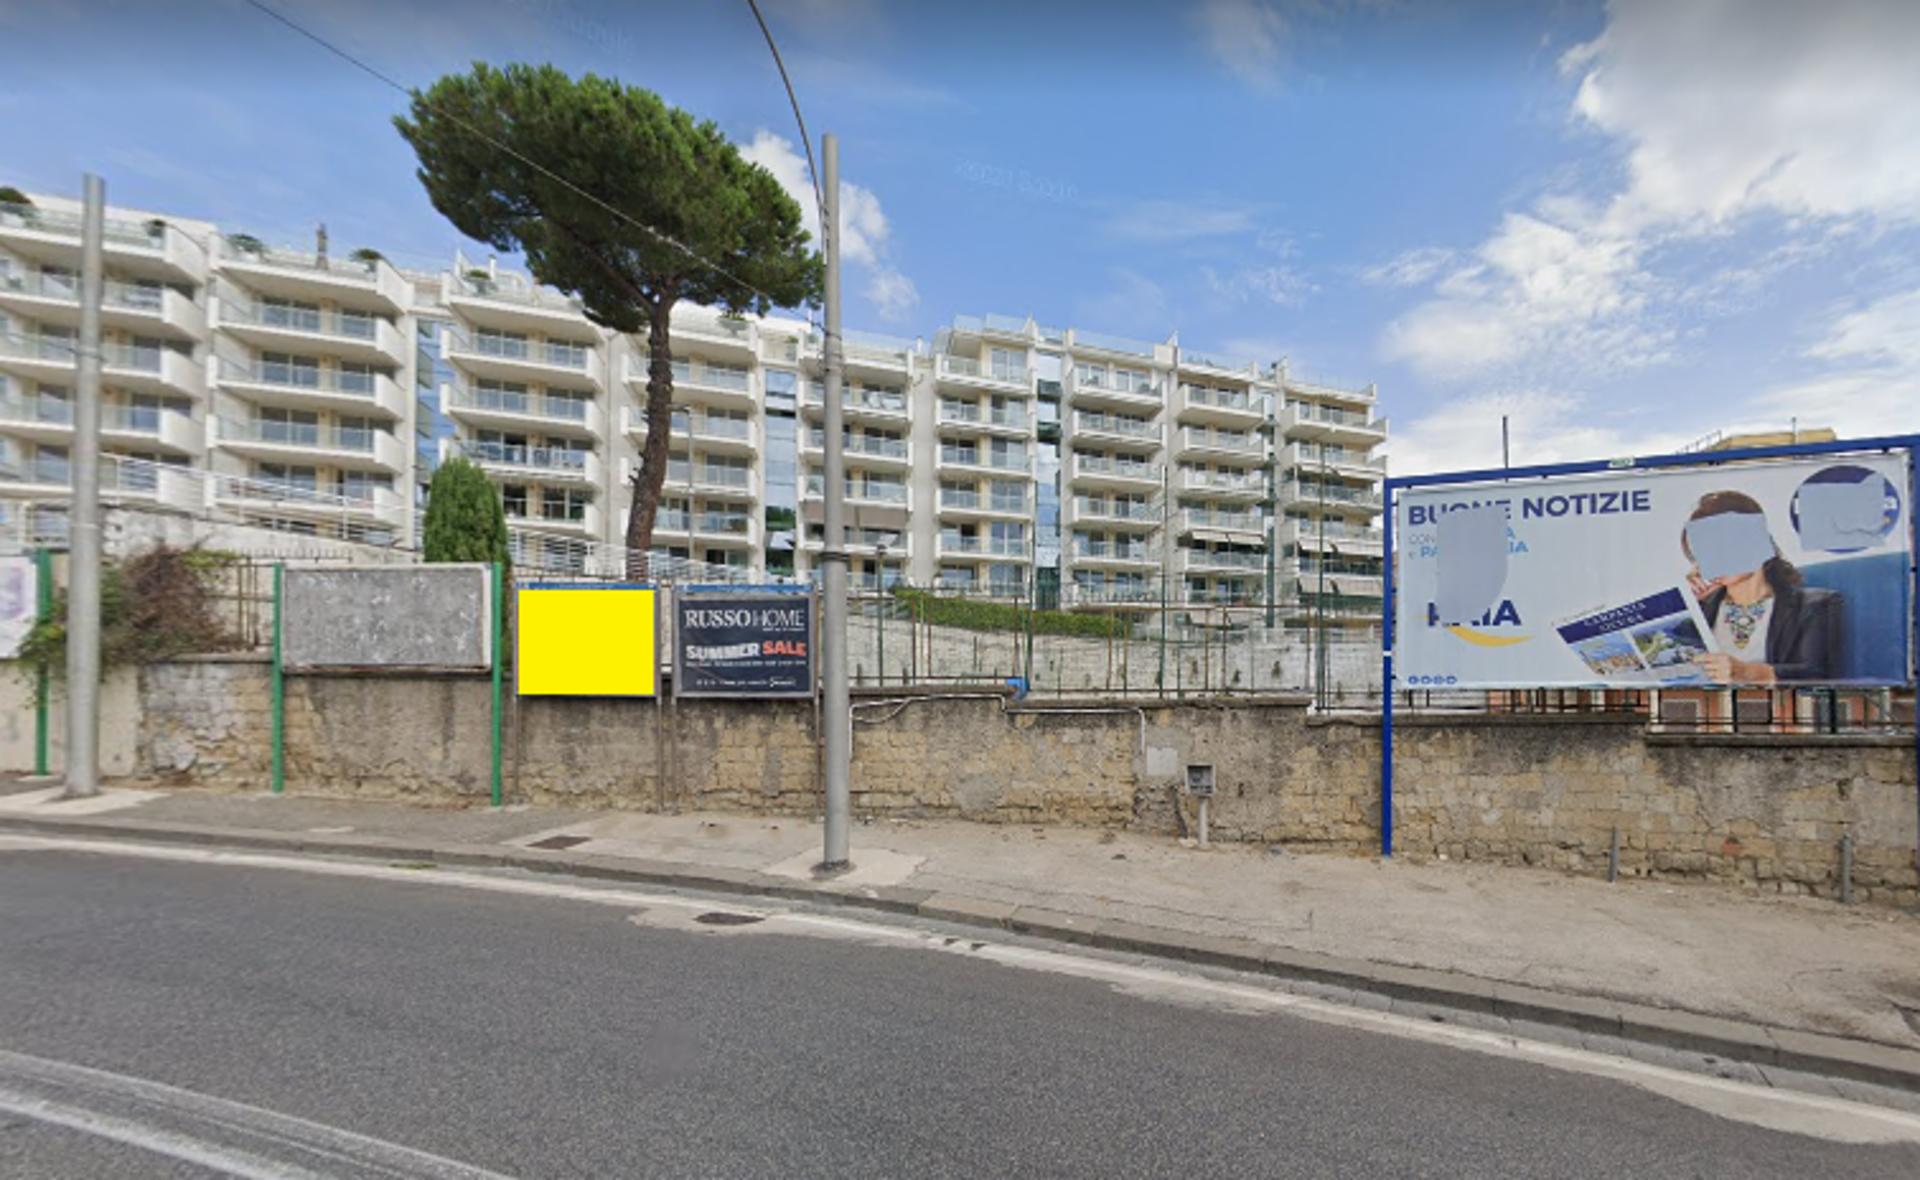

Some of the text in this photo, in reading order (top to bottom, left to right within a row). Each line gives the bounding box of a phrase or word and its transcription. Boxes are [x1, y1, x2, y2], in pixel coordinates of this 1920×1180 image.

[1522, 490, 1651, 519] NOTIZIE
[685, 640, 807, 660] SUMMER SALE
